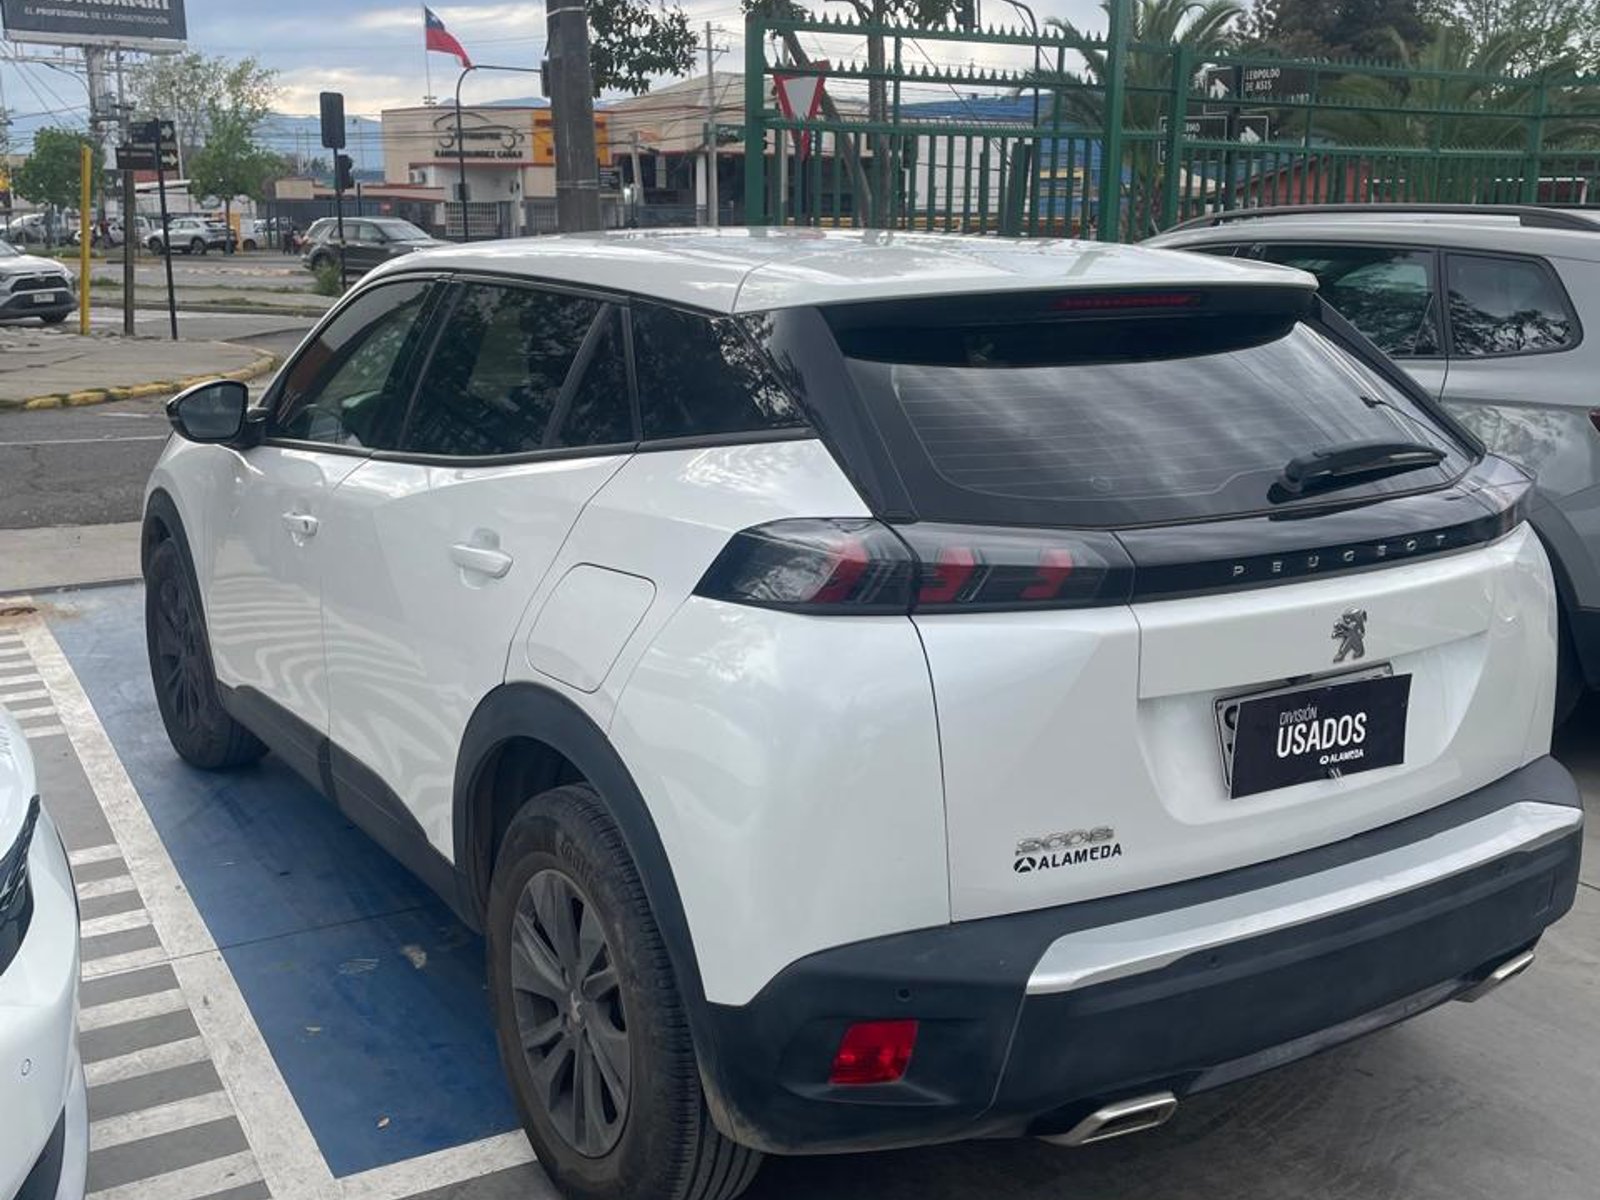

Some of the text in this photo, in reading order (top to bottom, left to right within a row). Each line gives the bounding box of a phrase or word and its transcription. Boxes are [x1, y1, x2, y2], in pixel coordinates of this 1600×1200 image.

[36, 8, 89, 18] PROFESIONAL
[1246, 68, 1281, 80] LEOPOLDO
[1233, 534, 1445, 576] PEUGEOT
[1280, 703, 1318, 725] DIVISIÓN
[1277, 711, 1367, 758] USADOS
[1330, 749, 1364, 764] ALAMEDA
[1038, 843, 1122, 870] ALAMEDA
